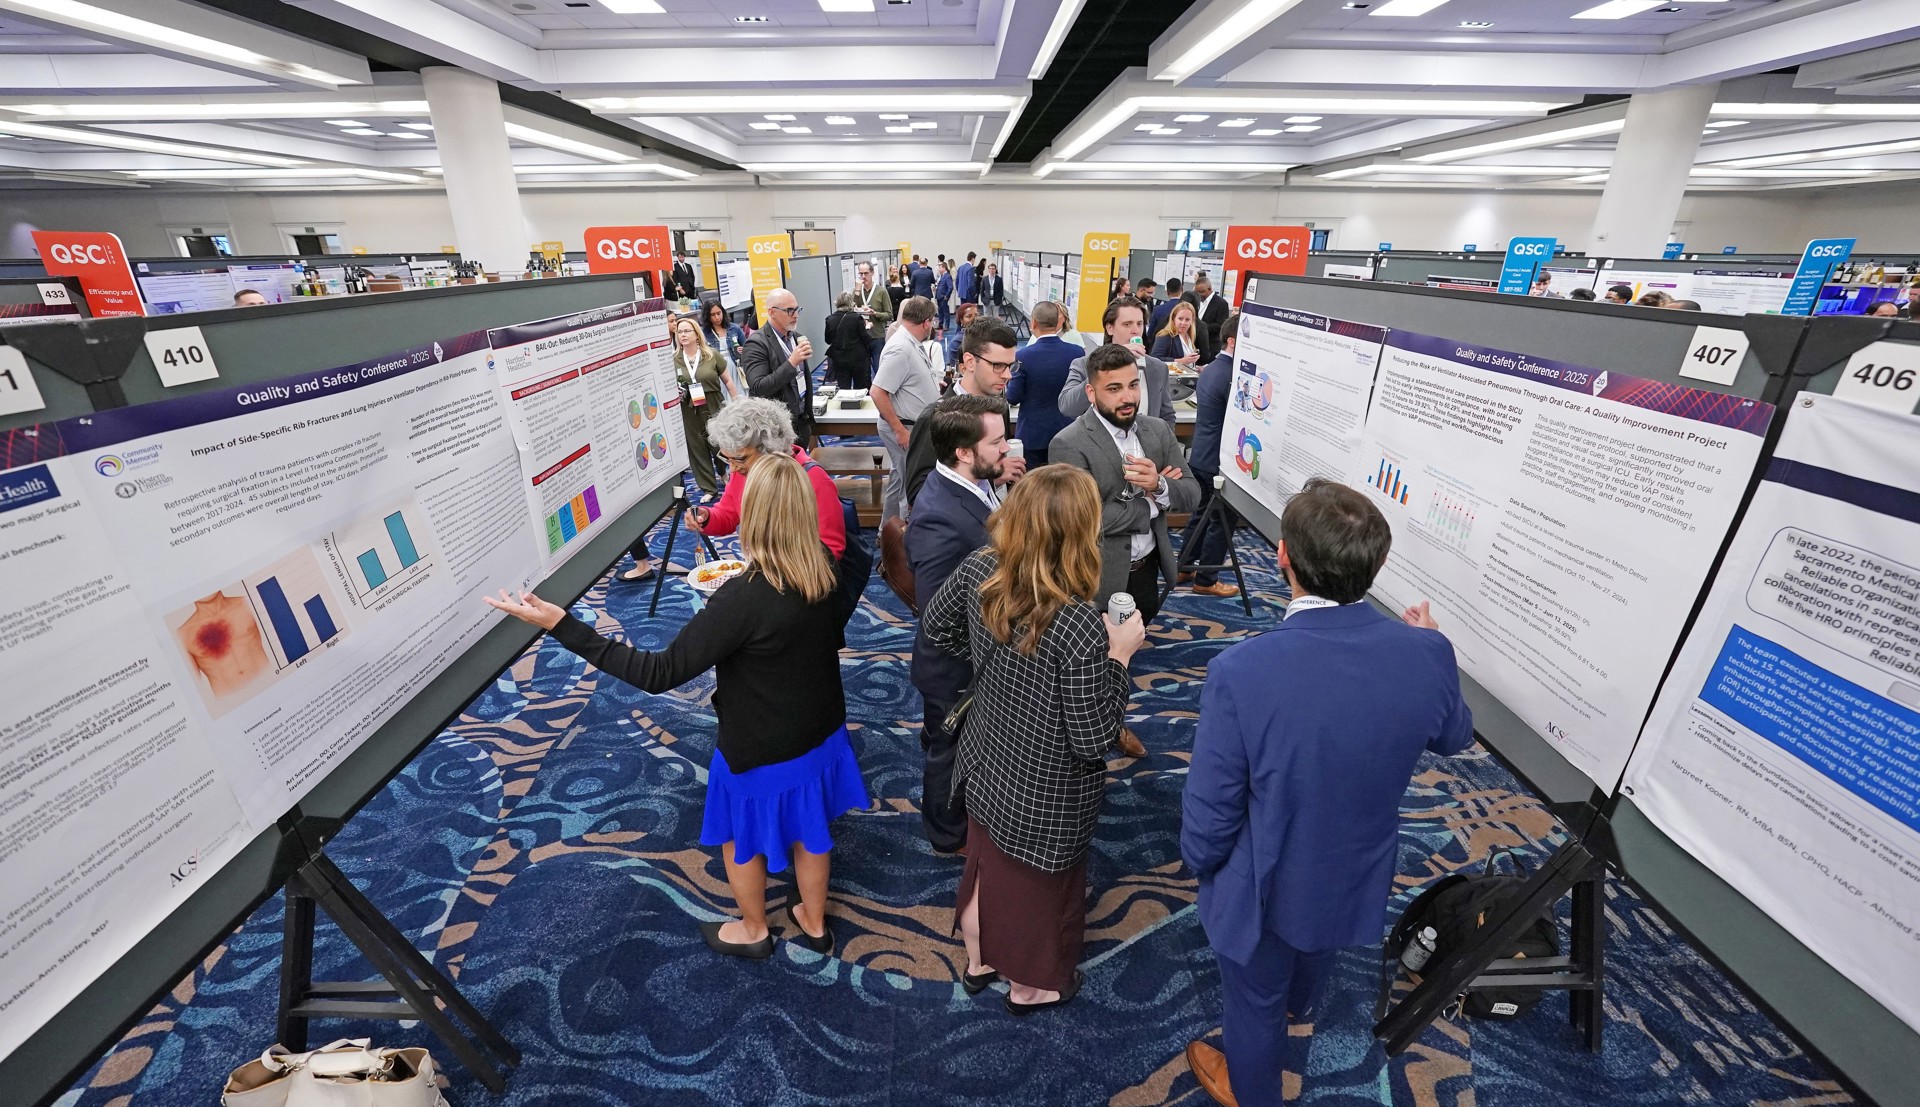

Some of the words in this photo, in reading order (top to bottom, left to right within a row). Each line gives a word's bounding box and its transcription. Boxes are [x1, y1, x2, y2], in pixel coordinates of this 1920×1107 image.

[596, 238, 652, 260] QSC
[753, 241, 781, 254] QSC
[1089, 239, 1119, 251] QSC
[1237, 237, 1290, 260] QSC
[1514, 243, 1545, 256] QSC
[1811, 245, 1843, 257] QSC
[50, 243, 105, 266] QSC
[44, 289, 65, 299] 433
[88, 288, 119, 299] Efficiency
[119, 288, 134, 296] and
[635, 284, 644, 294] 409
[1247, 284, 1255, 296] 408
[104, 297, 123, 305] Value
[100, 308, 137, 318] Emergency
[1272, 308, 1284, 319] Quality
[1282, 311, 1290, 319] and
[1287, 311, 1298, 322] Safety
[1296, 313, 1314, 325] Conference
[1313, 317, 1327, 327] 2025
[591, 326, 607, 337] Surgical
[163, 345, 204, 368] 410
[505, 355, 526, 366] Hartford
[1693, 344, 1737, 367] 407
[506, 360, 532, 373] HealthCare
[1454, 346, 1478, 362] Quality
[1475, 353, 1492, 364] and
[1490, 354, 1517, 370] Safety
[1516, 359, 1560, 379] Conference
[1562, 370, 1589, 385] 2025
[236, 385, 290, 406] Quality
[293, 377, 320, 394] and
[321, 371, 359, 388] Safety
[360, 357, 408, 379] Conference
[410, 349, 430, 364] 2025
[1853, 362, 1917, 391] 406
[189, 441, 225, 457] Impact
[226, 437, 237, 448] of
[237, 424, 292, 445] Side-Specific
[291, 420, 306, 431] Rib
[305, 412, 340, 427] Fractures
[339, 407, 353, 418] and
[352, 404, 368, 414] Lung
[366, 397, 387, 409] Injuries
[385, 395, 394, 403] on
[392, 387, 416, 400] Ventilator
[414, 379, 439, 393] Dependency
[442, 374, 450, 382] Rib
[448, 370, 462, 379] Plated
[460, 366, 478, 375] Patients
[1409, 360, 1419, 368] the
[1418, 361, 1431, 370] Risk
[1436, 365, 1458, 378] Ventilator
[1456, 372, 1487, 386] Associated
[1486, 379, 1522, 395] Pneumonia
[1522, 388, 1548, 403] Through
[1548, 395, 1564, 407] Oral
[1563, 399, 1584, 412] Care:
[1583, 405, 1591, 414] A
[1591, 407, 1621, 424] Quality
[1621, 415, 1685, 439] Improvement
[1686, 431, 1727, 450] Project
[121, 443, 163, 459] Community
[125, 451, 159, 466] Memorial
[162, 486, 217, 511] Retrospective
[217, 475, 248, 491] analysis
[248, 471, 258, 480] of
[258, 464, 286, 480] trauma
[286, 455, 315, 470] patients
[314, 449, 330, 460] with
[329, 442, 354, 455] complex
[353, 438, 362, 447] rib
[360, 431, 382, 443] fractures
[16, 511, 44, 525] major
[44, 499, 81, 516] Surgical
[323, 538, 332, 552] STAY
[1785, 532, 1796, 544] In
[1795, 536, 1819, 552] late
[1818, 544, 1856, 566] 2022,
[1859, 558, 1883, 574] the
[328, 553, 336, 561] OF
[408, 565, 420, 576] LATE
[342, 580, 357, 607] HOSPITAL
[374, 601, 386, 613] TIME
[384, 597, 392, 605] TO
[390, 584, 413, 601] SURGICAL
[410, 572, 431, 588] FIXATION
[375, 585, 389, 597] EARLY
[325, 637, 340, 649] Right
[295, 658, 308, 669] Left
[1737, 636, 1753, 650] The
[1752, 645, 1779, 662] team
[1778, 658, 1820, 684] executed
[1818, 681, 1827, 689] a
[1826, 684, 1872, 710] tailored
[1870, 706, 1920, 735] strategy
[1544, 721, 1567, 741] ACS
[1670, 758, 1704, 785] Harpreet
[1703, 781, 1734, 808] Kooner,
[1735, 803, 1750, 819] RN,
[1751, 815, 1774, 837] MBA,
[1776, 833, 1798, 854] BSN,
[1799, 850, 1830, 877] CPHQ,
[1832, 873, 1863, 897] HACP
[169, 855, 198, 888] ACS
